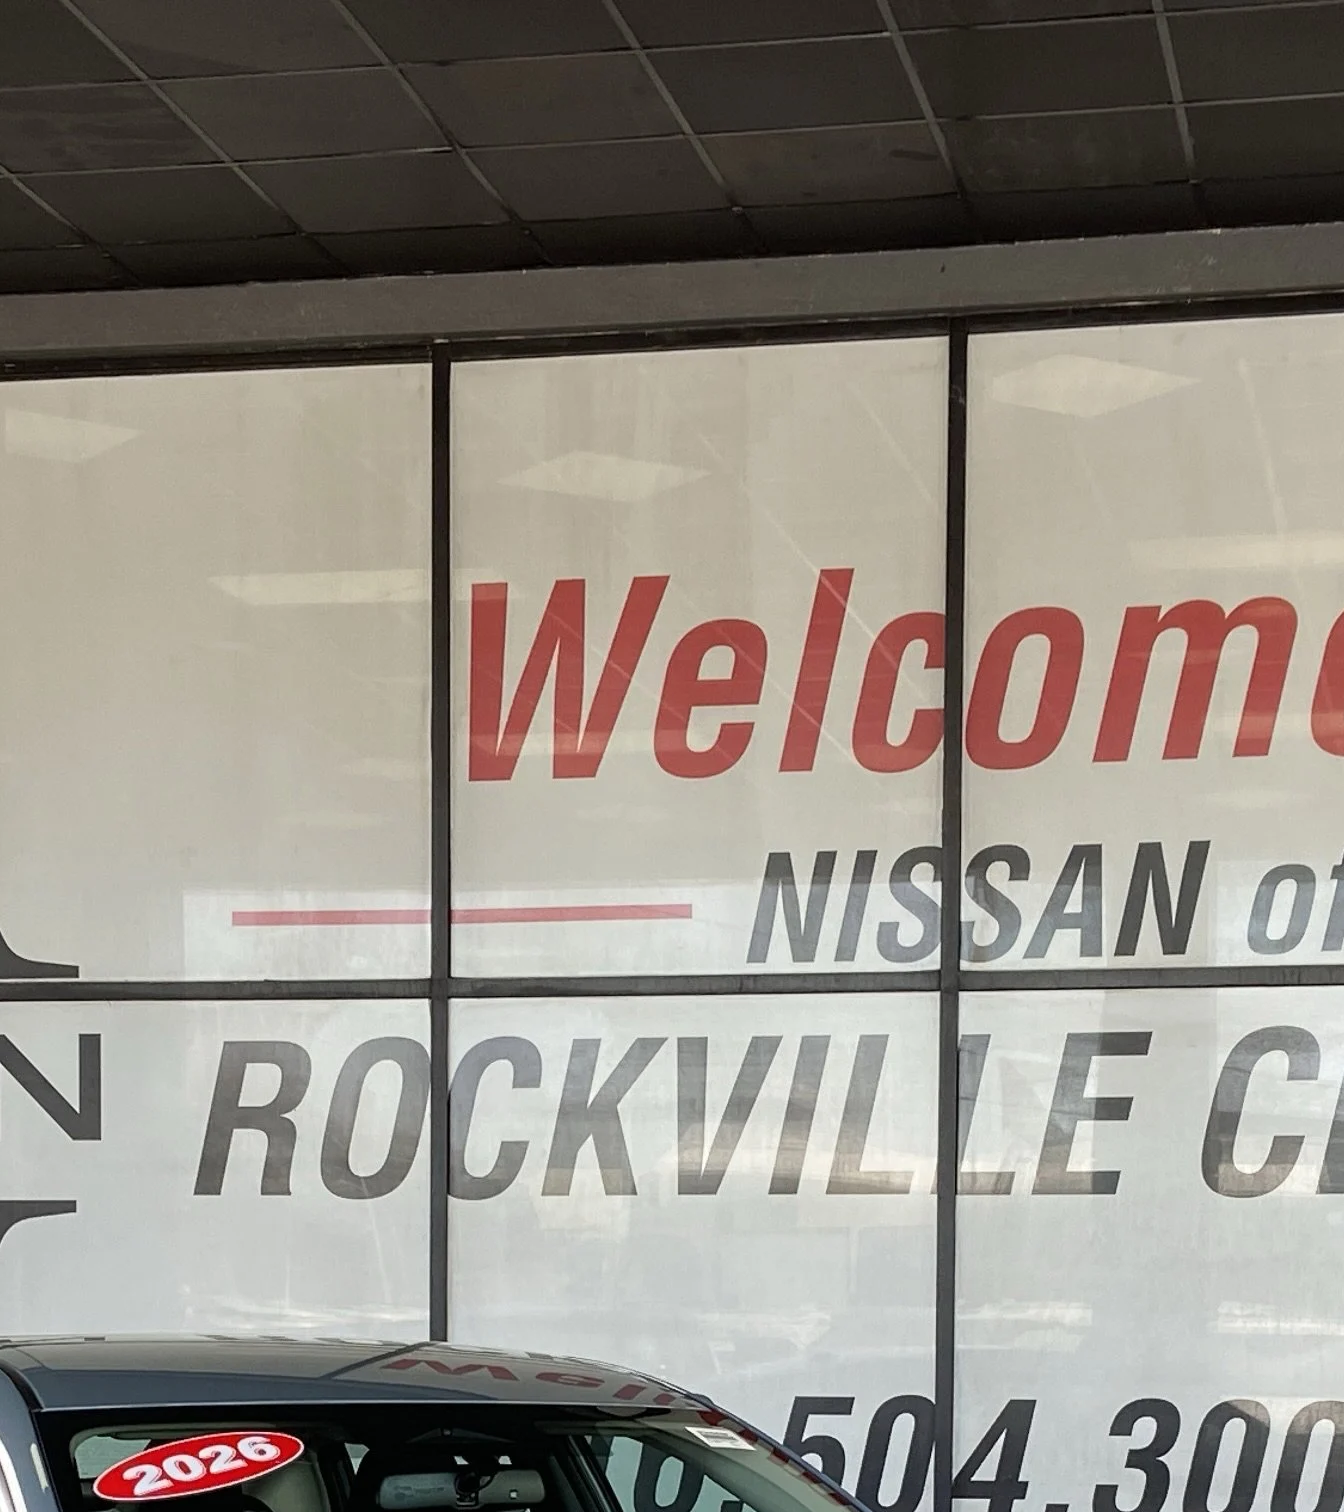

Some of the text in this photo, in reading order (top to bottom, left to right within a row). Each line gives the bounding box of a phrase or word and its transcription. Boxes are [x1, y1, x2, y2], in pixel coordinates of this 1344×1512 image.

[747, 840, 1210, 964] NISSAN
[193, 1031, 1153, 1201] ROCKVILLE
[121, 1435, 282, 1496] 2026
